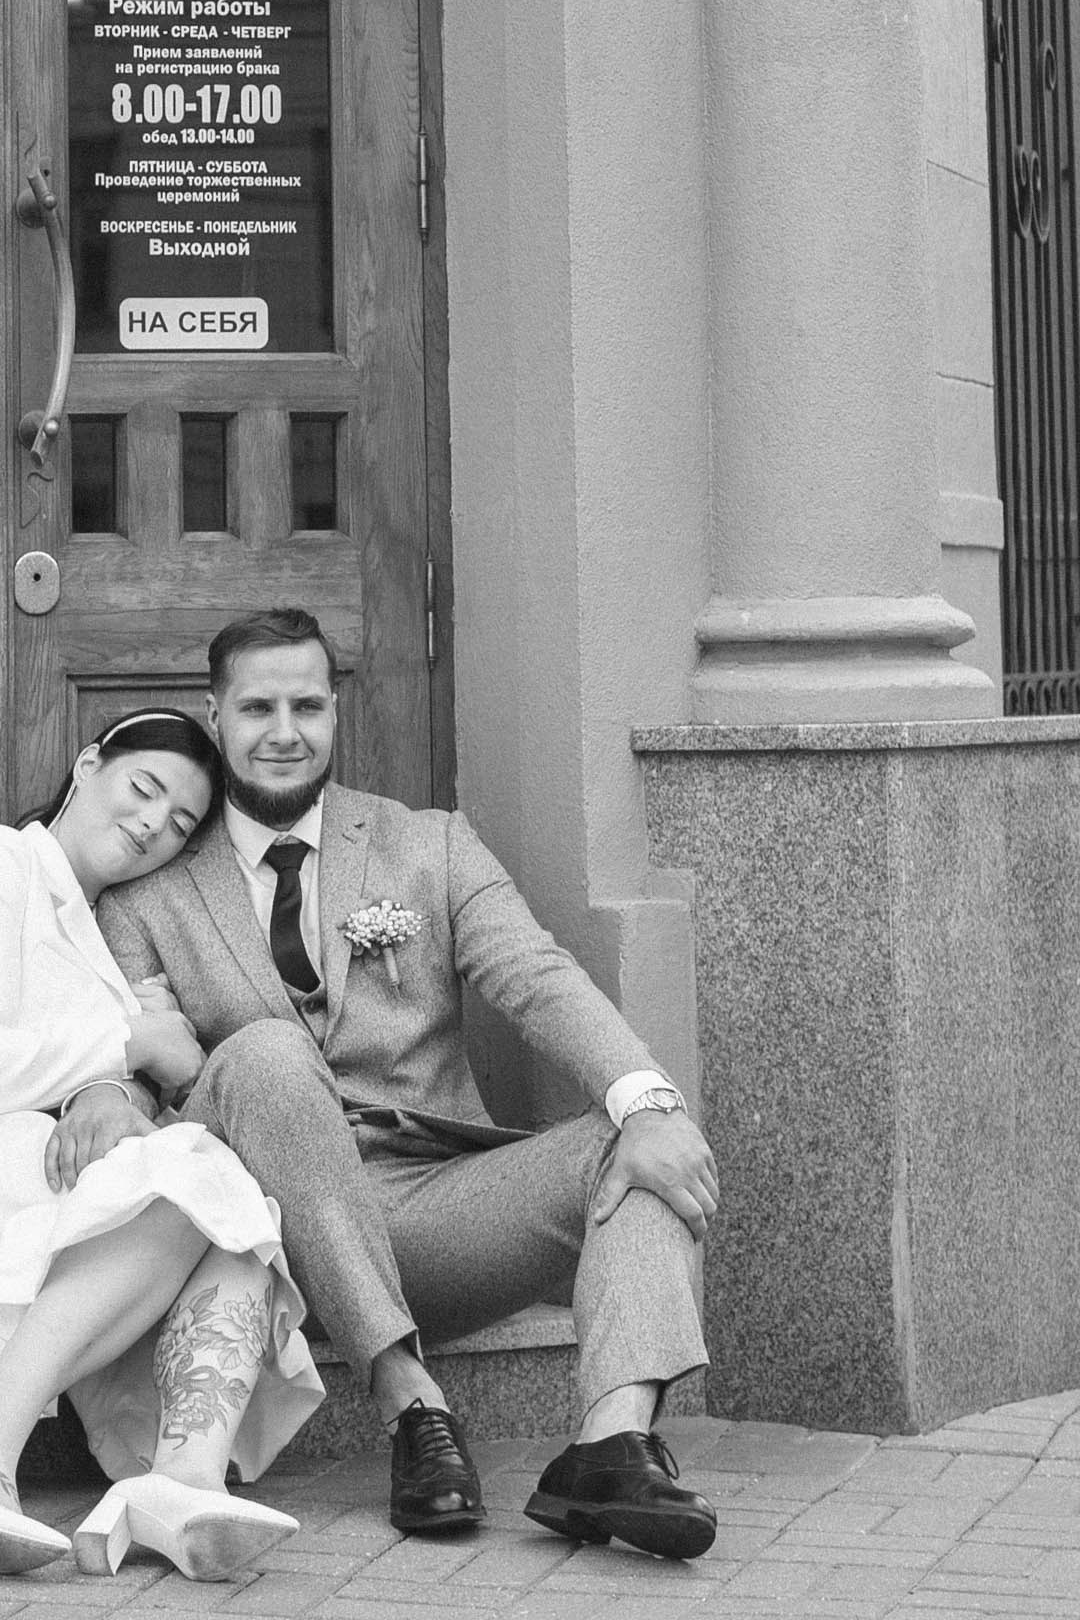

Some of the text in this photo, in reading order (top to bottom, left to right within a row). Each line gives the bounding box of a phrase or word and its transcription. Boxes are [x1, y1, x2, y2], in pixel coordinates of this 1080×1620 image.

[94, 24, 161, 38] ВТОРНИК
[171, 25, 219, 40] СРЕДА
[231, 25, 292, 39] ЧЕТВЕРГ
[133, 44, 263, 60] Прием заявлений
[115, 61, 281, 77] на регистрацию брака
[111, 82, 282, 125] 8.00-17.00
[142, 128, 255, 145] обед 13.00-14.00
[129, 160, 195, 175] ПЯТНИЦА
[205, 160, 268, 174] СУББОТА
[95, 174, 302, 189] Проведение торжественных
[157, 188, 240, 205] церемоний
[100, 220, 194, 234] ВОСКРЕСЕНЬЕ
[203, 220, 297, 236] ПОНЕДЕЛЬНИК
[149, 237, 250, 258] Выходной
[128, 311, 257, 333] НА СЕБЯ
